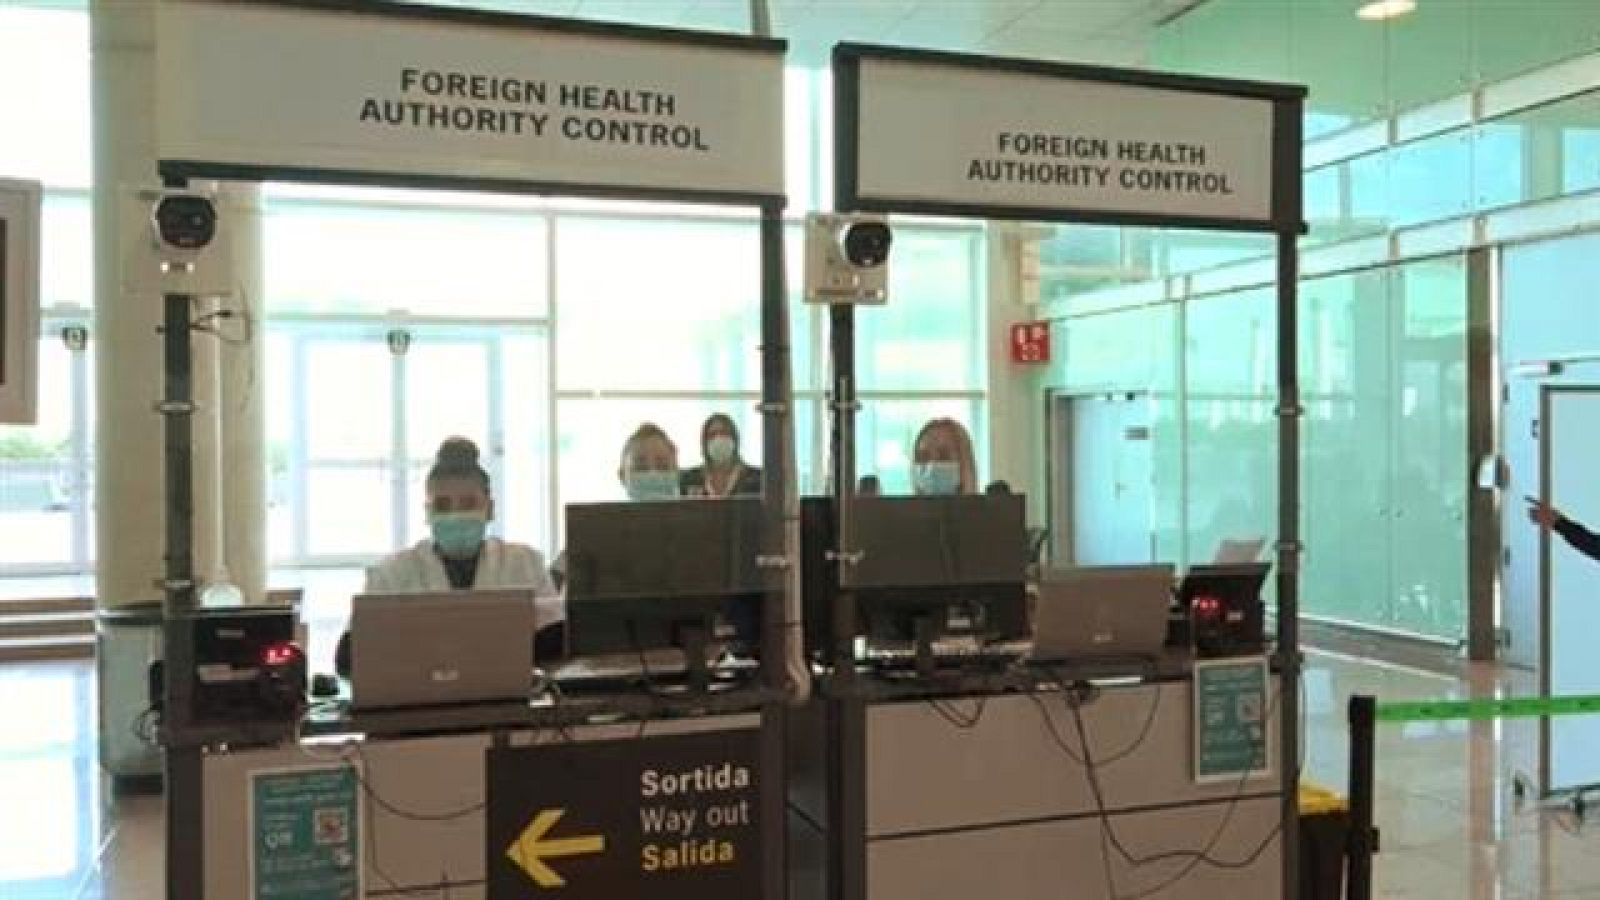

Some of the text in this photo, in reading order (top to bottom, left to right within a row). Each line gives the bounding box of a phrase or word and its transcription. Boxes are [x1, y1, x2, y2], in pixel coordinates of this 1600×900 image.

[401, 68, 676, 116] FOREIGN HEALTH
[359, 99, 710, 151] AUTHORITY CONTROL
[999, 132, 1206, 165] FOREIGN HEALTH
[967, 159, 1234, 195] AUTHORITY CONTROL
[641, 762, 750, 796] Sortida
[641, 800, 749, 836] Way out
[641, 839, 734, 871] Salida
